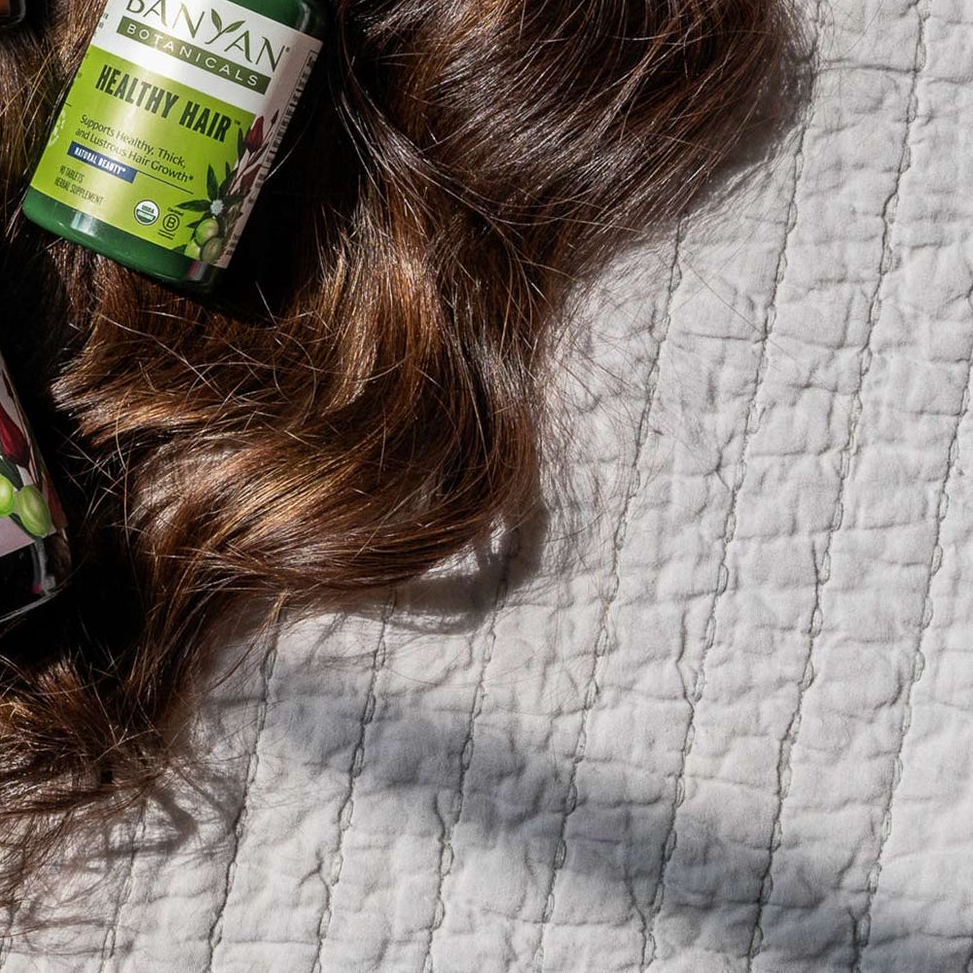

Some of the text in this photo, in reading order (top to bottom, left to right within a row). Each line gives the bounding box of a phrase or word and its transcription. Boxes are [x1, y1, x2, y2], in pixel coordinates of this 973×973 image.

[127, 23, 259, 87] BOTANICALS
[95, 64, 179, 119] HEALTHY
[179, 100, 232, 143] HAIR
[74, 147, 97, 164] NATURAL
[75, 128, 89, 140] and
[90, 134, 127, 157] Lustrous
[128, 151, 150, 167] Hair
[79, 114, 115, 137] Supports
[158, 148, 186, 169] Thick,
[66, 167, 85, 184] TABLETS
[70, 184, 104, 205] SUPPLEMENT
